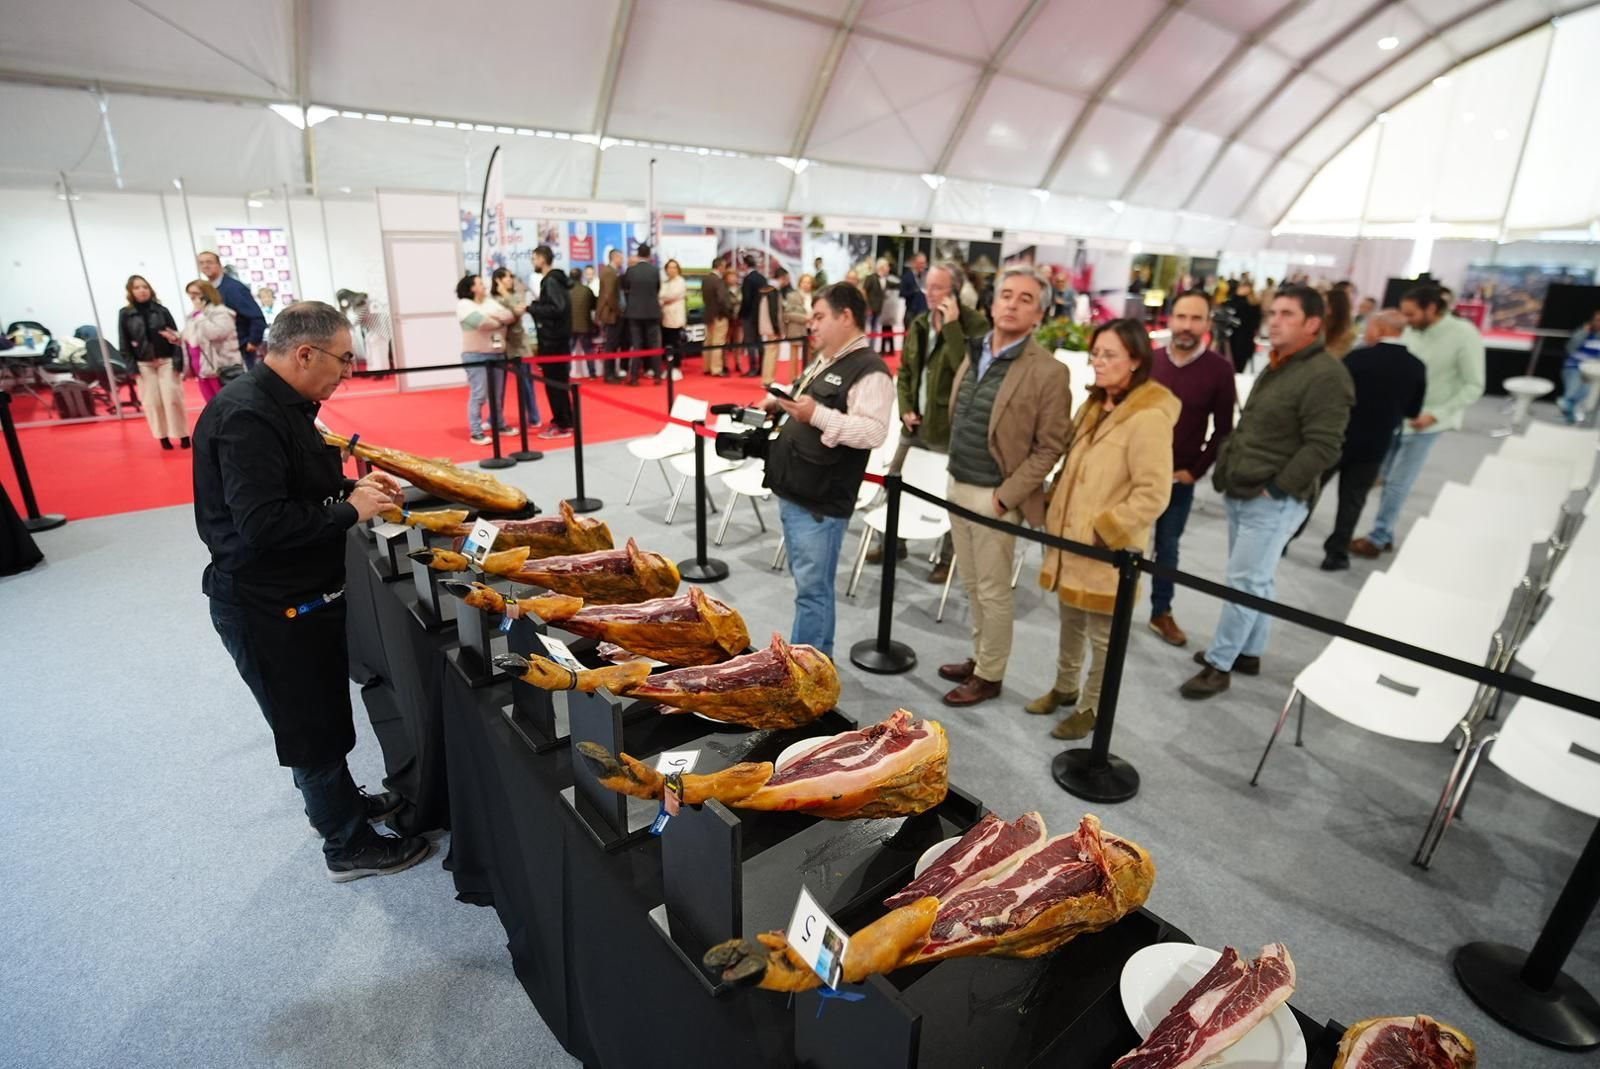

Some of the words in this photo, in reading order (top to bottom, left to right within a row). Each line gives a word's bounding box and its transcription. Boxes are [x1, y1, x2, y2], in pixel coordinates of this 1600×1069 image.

[486, 208, 497, 246] chc
[549, 642, 563, 651] 7
[802, 915, 817, 942] 5
